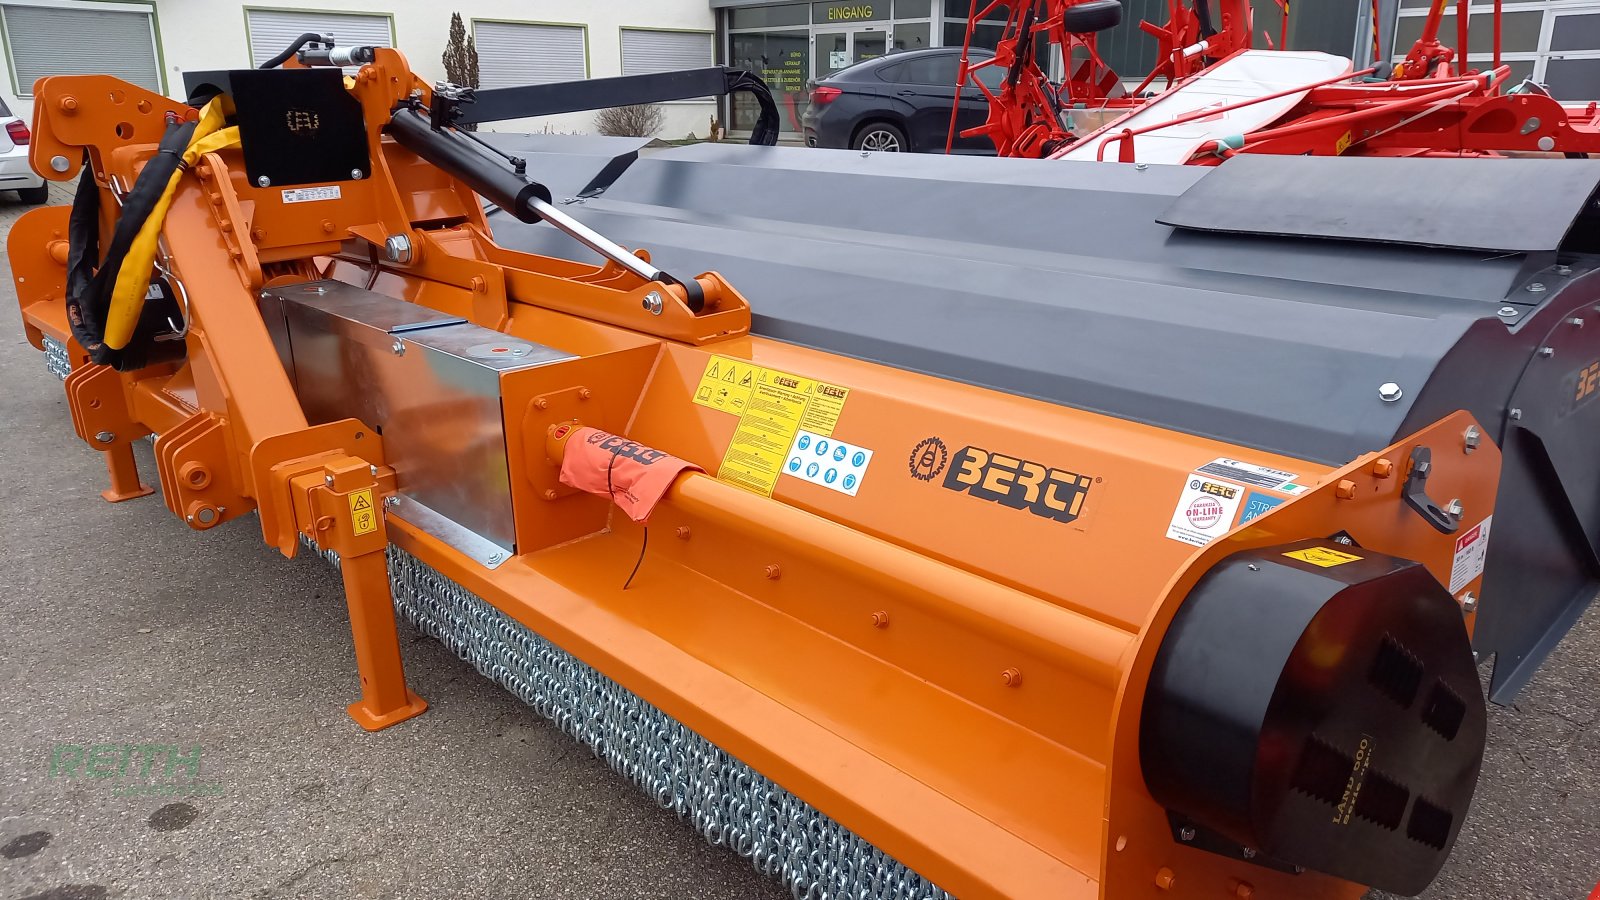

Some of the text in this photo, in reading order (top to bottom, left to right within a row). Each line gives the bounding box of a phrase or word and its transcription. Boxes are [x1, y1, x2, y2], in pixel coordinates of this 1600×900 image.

[828, 5, 873, 20] EINGANG
[942, 445, 1093, 524] BERTI
[1186, 506, 1224, 517] ON-LINE
[1332, 776, 1354, 825] LAND
